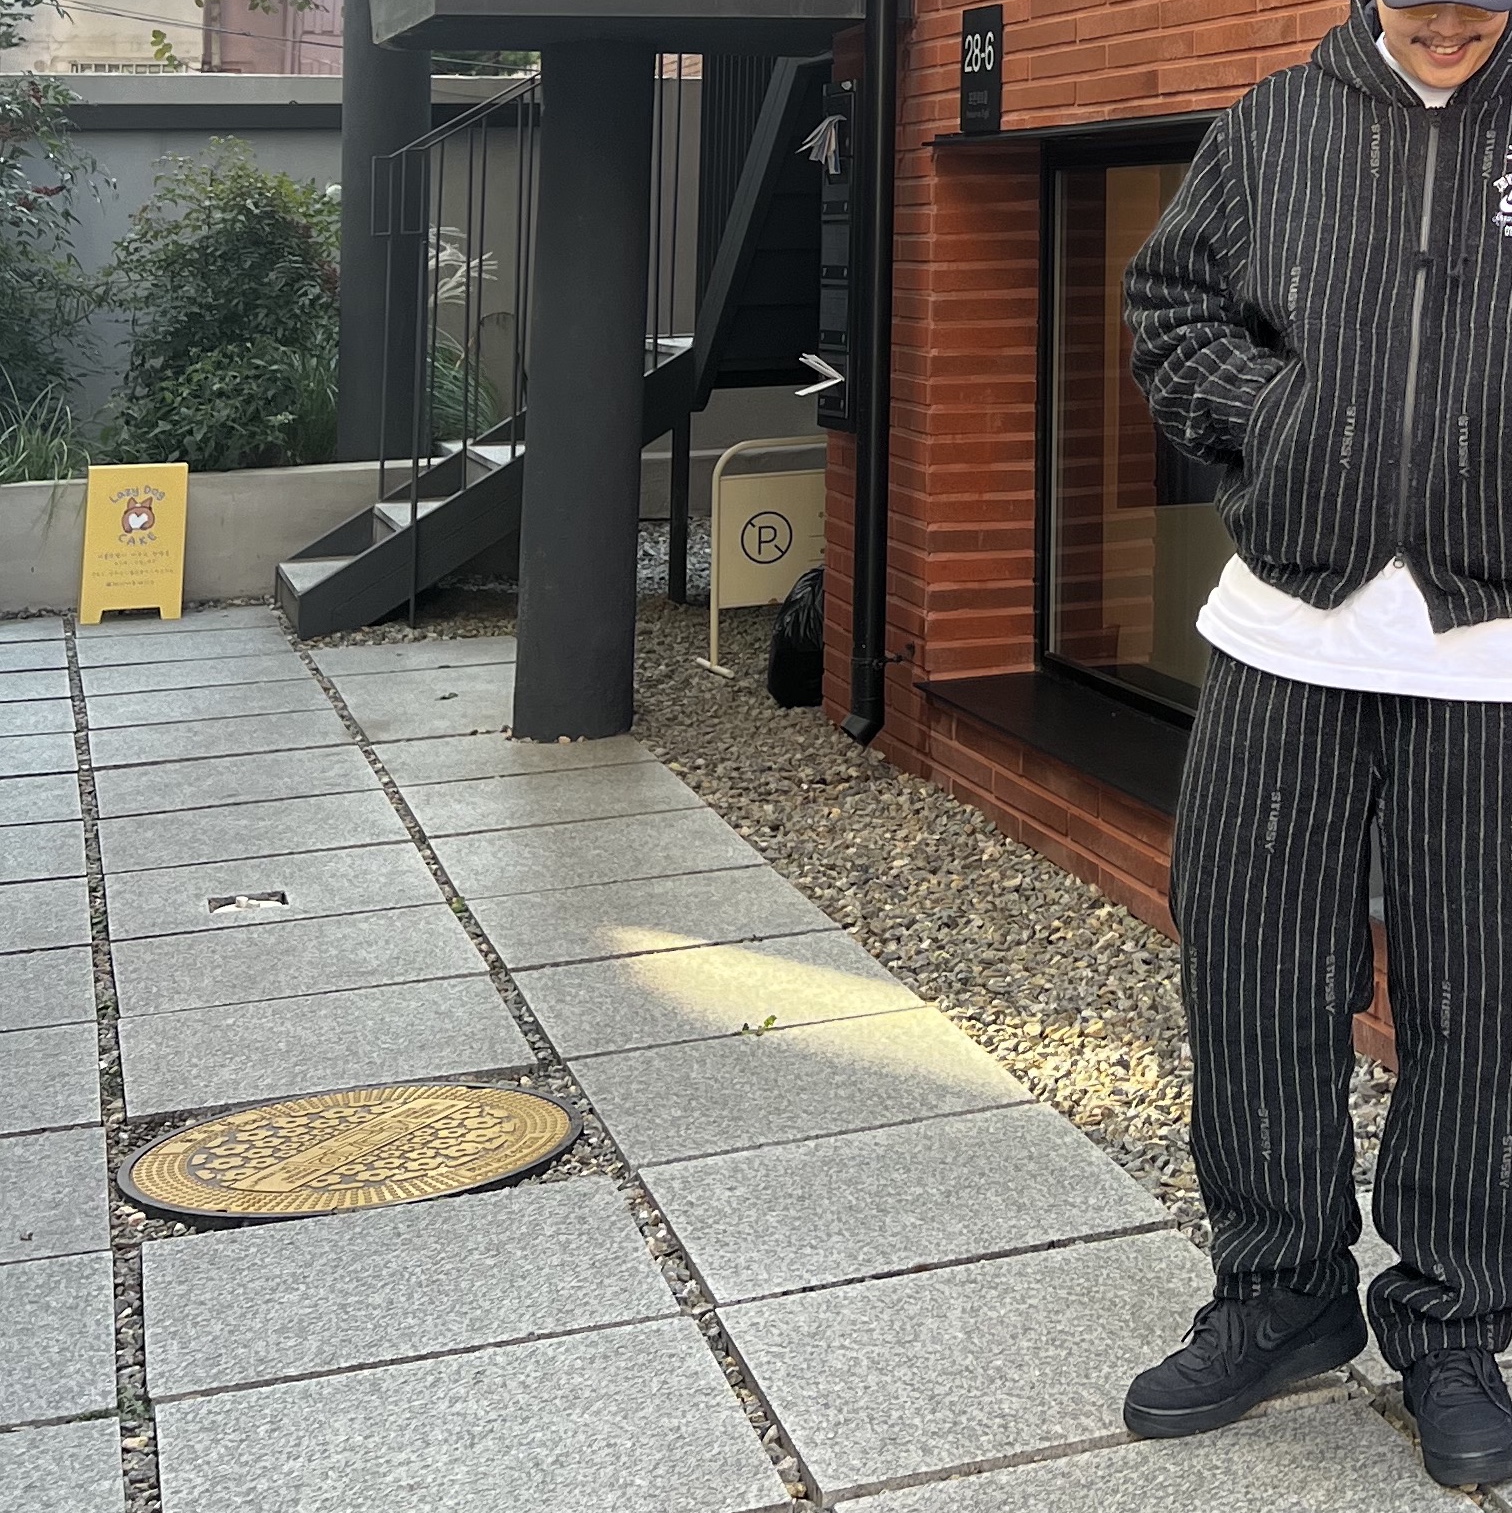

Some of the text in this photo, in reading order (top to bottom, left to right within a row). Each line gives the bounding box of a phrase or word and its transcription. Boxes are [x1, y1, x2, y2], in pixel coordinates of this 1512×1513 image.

[964, 31, 995, 73] 28-6
[1369, 123, 1381, 180] STUSSY
[1481, 129, 1498, 179] STUSSY
[1457, 414, 1471, 478] STUSSY
[1265, 791, 1281, 855] STUSSY
[1325, 955, 1337, 1015] STUSSY
[1441, 980, 1452, 1039] STUSSY
[1257, 1108, 1272, 1162] STUSSY
